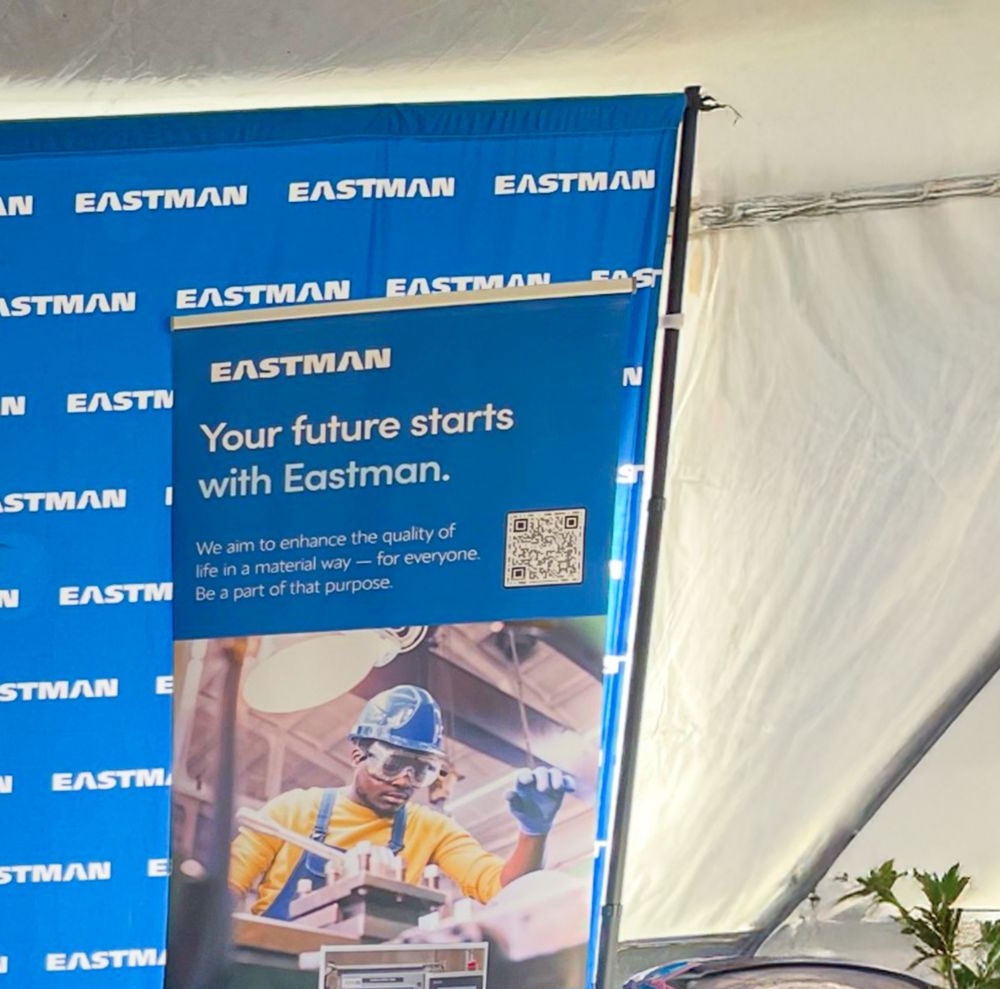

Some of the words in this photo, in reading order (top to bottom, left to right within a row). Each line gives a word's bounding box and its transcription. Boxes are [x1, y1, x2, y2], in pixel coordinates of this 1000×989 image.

[75, 185, 248, 213] EASTMAN
[288, 177, 455, 203] EASTMAN
[494, 169, 655, 195] EASTMAN
[176, 280, 351, 310] EASTMAN
[211, 348, 391, 383] EASTMAN
[67, 389, 173, 413] EASTM
[200, 422, 283, 453] Your
[291, 414, 401, 446] future
[410, 403, 514, 437] starts
[198, 465, 271, 499] with
[284, 460, 450, 493] Eastman.
[196, 541, 222, 556] We
[226, 538, 255, 554] aim
[259, 537, 276, 552] to
[280, 533, 347, 550] enhance
[351, 529, 378, 546] the
[382, 525, 434, 546] quality
[438, 522, 456, 540] of
[195, 563, 219, 579] life
[223, 562, 237, 577] in
[241, 564, 250, 576] a
[255, 556, 316, 575] material
[320, 557, 351, 574] way
[376, 550, 400, 567] for
[404, 547, 480, 566] everyone.
[59, 582, 173, 606] EASTM
[195, 586, 216, 601] Be
[220, 587, 229, 600] a
[233, 582, 264, 602] part
[268, 579, 286, 597] of
[290, 577, 320, 595] that
[325, 575, 393, 595] purpose.
[52, 767, 172, 792] EASTM
[46, 948, 167, 972] EASTM
